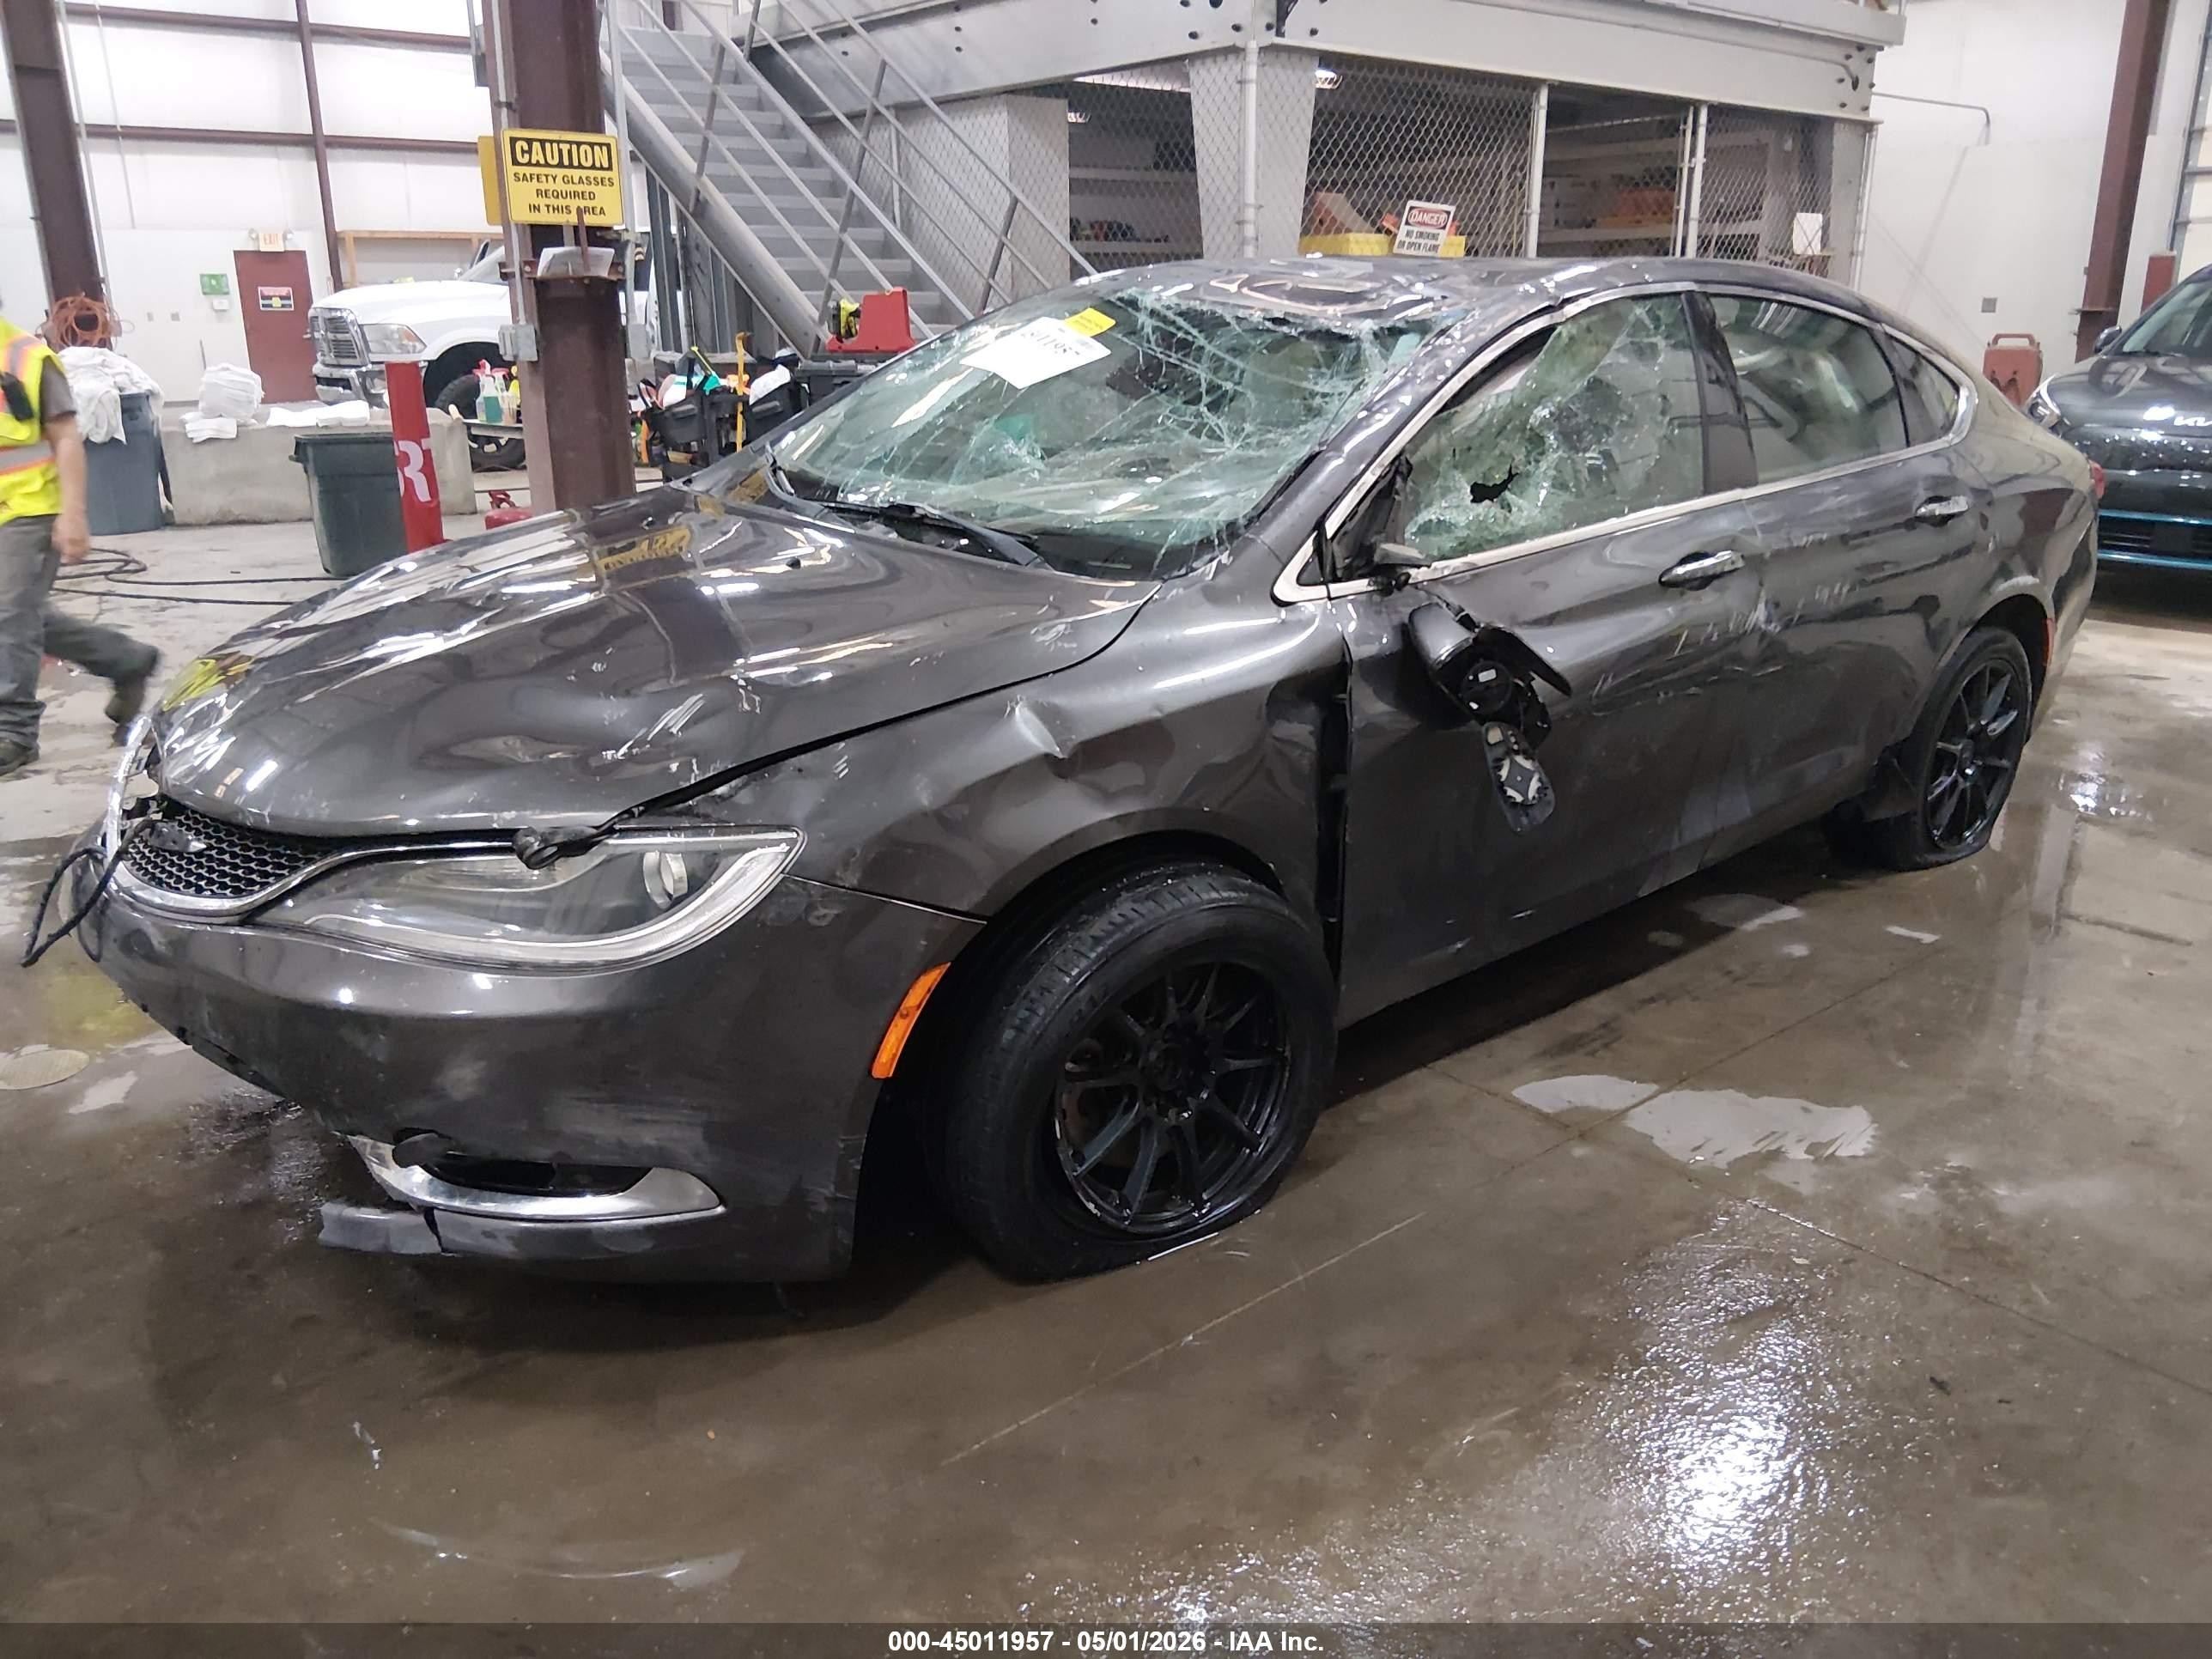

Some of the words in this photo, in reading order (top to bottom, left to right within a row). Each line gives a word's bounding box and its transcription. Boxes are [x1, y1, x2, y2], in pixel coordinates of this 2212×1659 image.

[516, 140, 609, 167] CAUTION
[514, 172, 557, 184] SAFETY
[562, 174, 615, 187] GLASSES
[536, 189, 595, 201] REQUIRED
[528, 203, 541, 214] IN
[544, 204, 572, 215] THIS
[576, 205, 606, 216] REA
[1411, 211, 1445, 224] DANGER
[1406, 229, 1414, 239] NO
[1397, 240, 1406, 249] OR
[1407, 241, 1422, 252] OPEN
